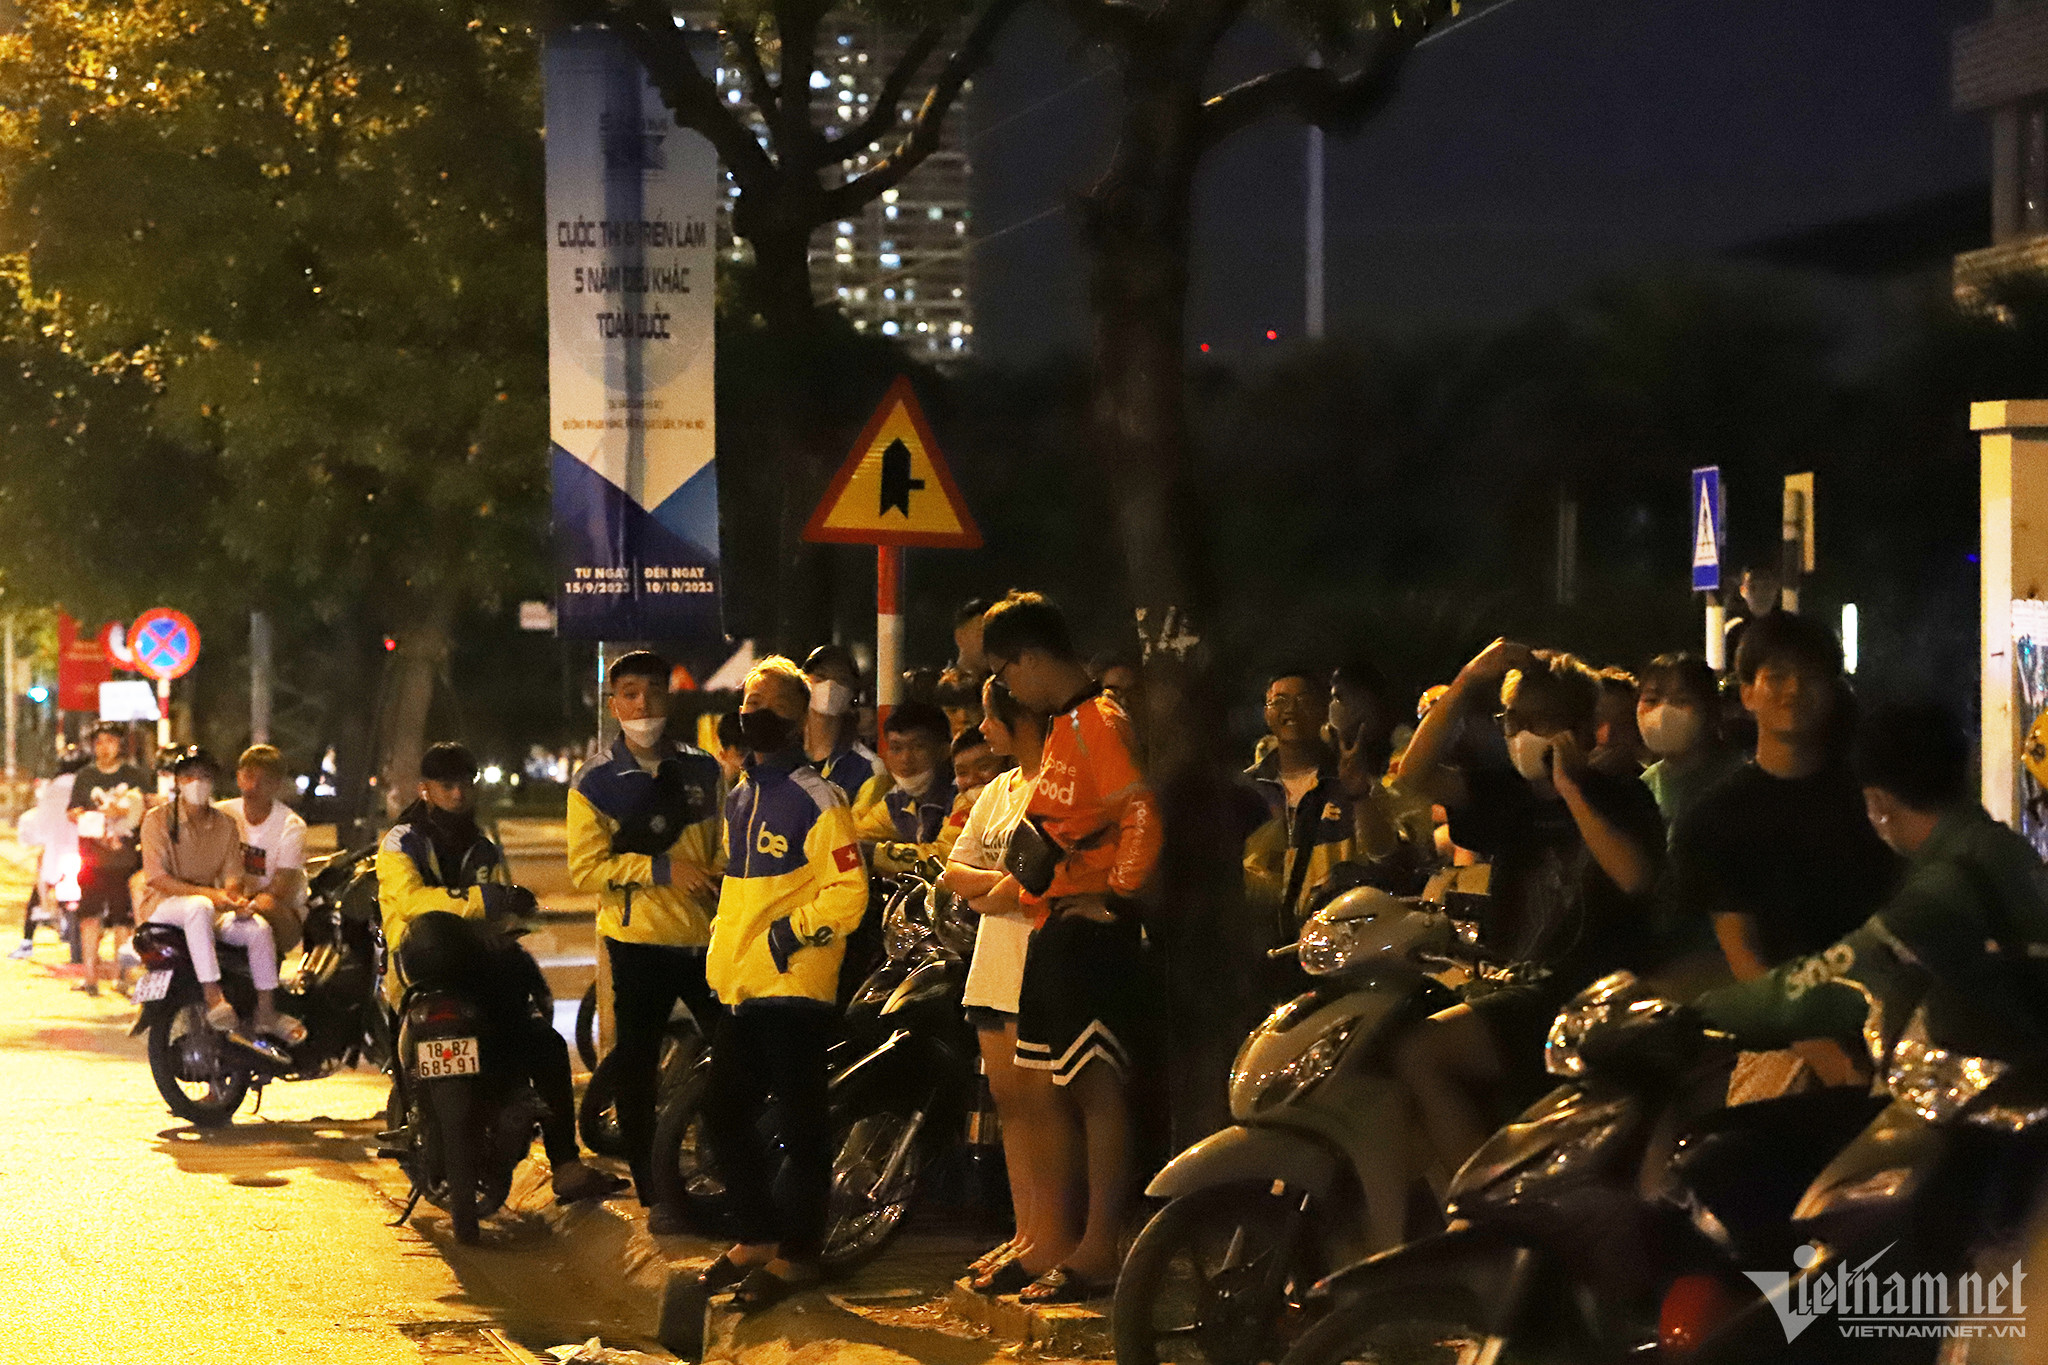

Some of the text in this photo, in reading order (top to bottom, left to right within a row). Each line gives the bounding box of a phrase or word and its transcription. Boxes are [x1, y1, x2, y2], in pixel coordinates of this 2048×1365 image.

[575, 267, 584, 294] 5
[565, 582, 630, 594] 15/9/2023
[645, 581, 714, 593] 10/10/2023
[1038, 778, 1075, 806] ood
[757, 821, 788, 858] be
[421, 1056, 477, 1077] 685.91
